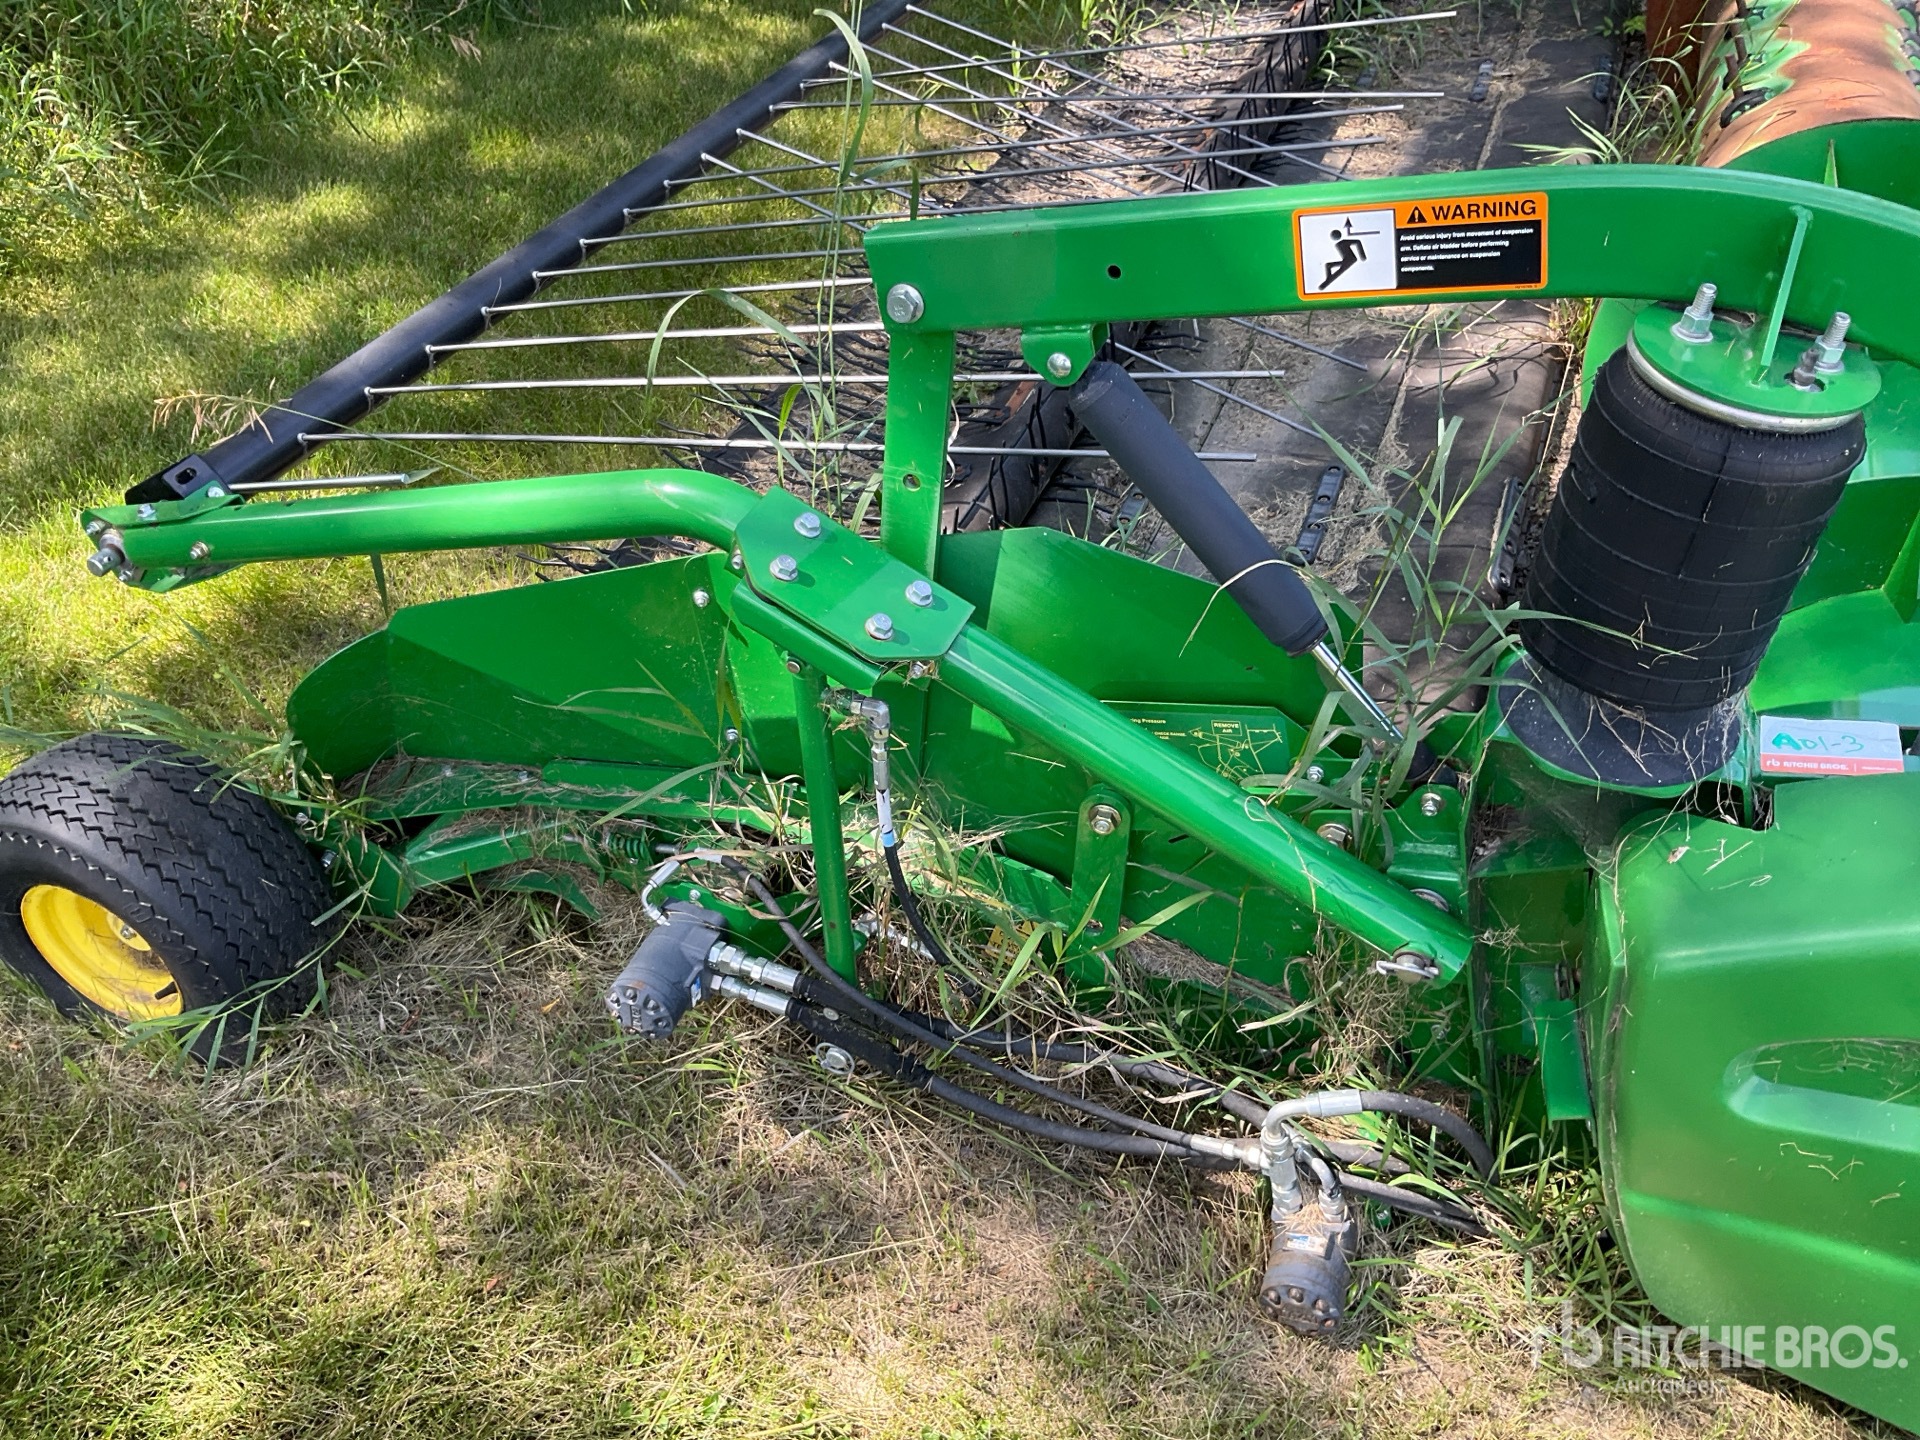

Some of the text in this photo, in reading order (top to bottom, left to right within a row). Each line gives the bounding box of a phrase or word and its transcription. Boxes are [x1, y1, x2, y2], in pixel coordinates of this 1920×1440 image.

[1431, 199, 1536, 221] WARNING
[1436, 232, 1452, 240] injury
[1466, 229, 1494, 237] movement
[1502, 227, 1534, 236] suspension
[1479, 240, 1509, 248] performing
[1427, 253, 1460, 261] maintenance
[1469, 251, 1501, 259] suspension
[1400, 265, 1435, 273] components.
[1783, 761, 1818, 769] RITCHIE
[1820, 763, 1849, 771] BROS.
